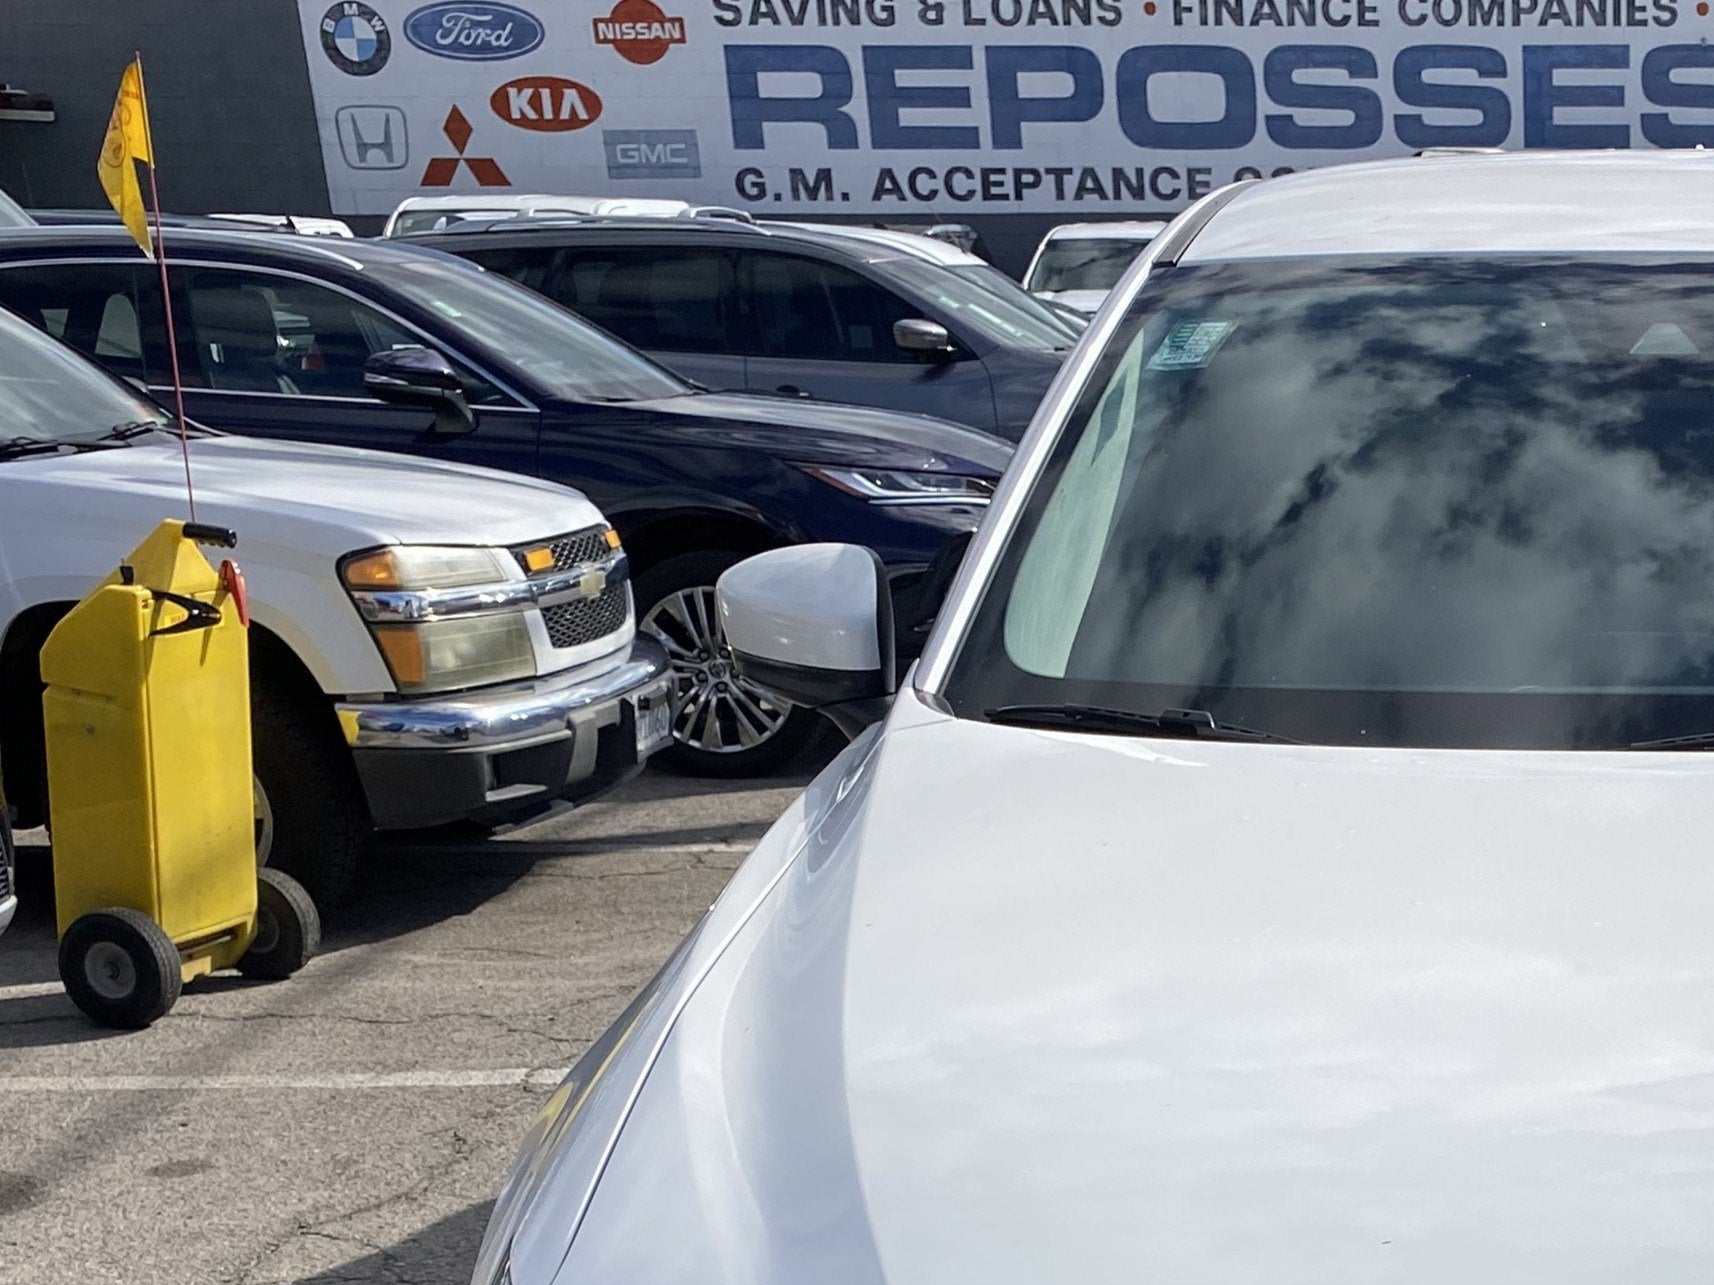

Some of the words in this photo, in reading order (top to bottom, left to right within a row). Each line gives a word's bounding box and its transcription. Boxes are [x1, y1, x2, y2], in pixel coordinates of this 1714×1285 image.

[321, 3, 386, 33] BMW
[713, 0, 896, 27] SAVING
[964, 0, 1123, 26] LOANS
[1173, 0, 1381, 27] FINANCE
[1400, 0, 1679, 27] COMPANIES
[435, 12, 514, 47] Ford
[597, 22, 681, 40] NISSAN
[507, 87, 589, 120] KIA
[616, 143, 688, 164] GMC
[734, 167, 850, 201] G.M.
[872, 166, 1213, 201] ACCEPTANCE
